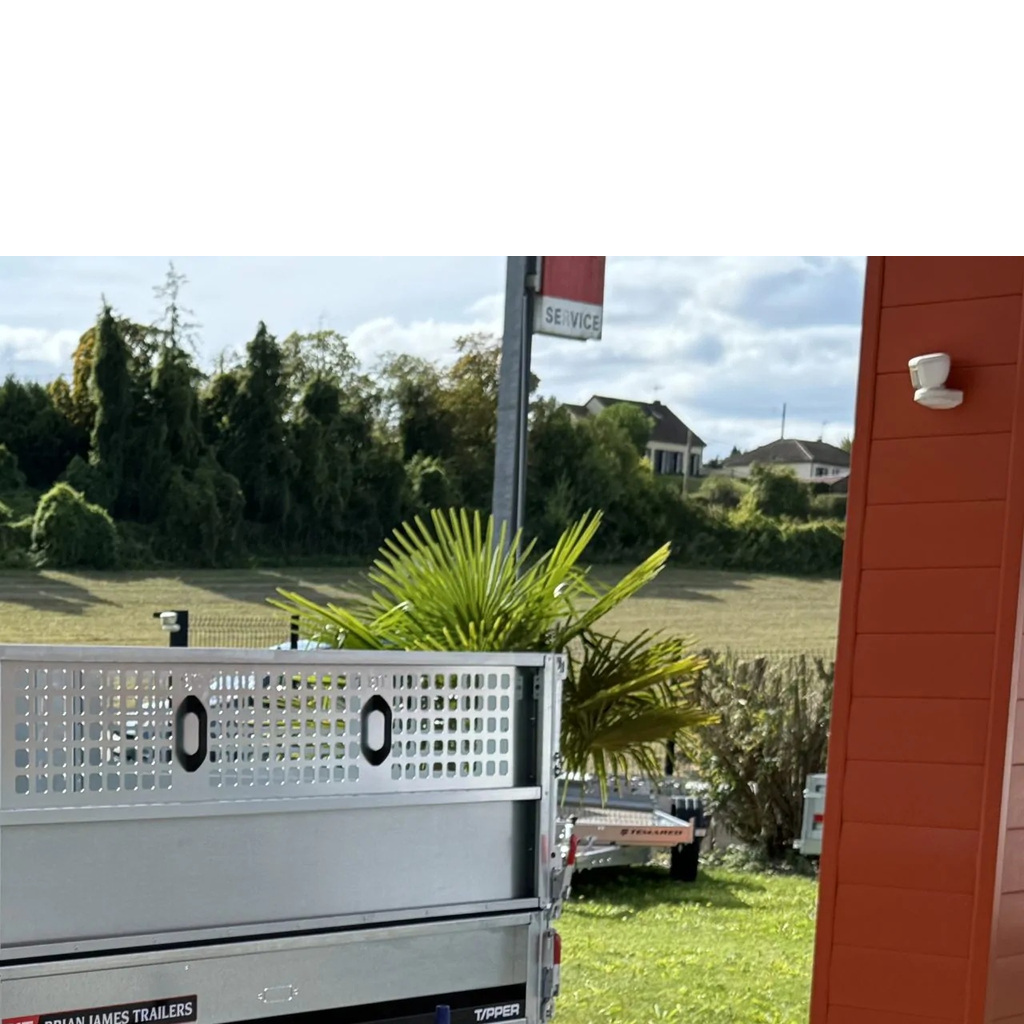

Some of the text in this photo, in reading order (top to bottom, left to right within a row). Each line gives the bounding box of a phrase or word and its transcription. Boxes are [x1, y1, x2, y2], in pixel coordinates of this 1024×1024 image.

[545, 306, 600, 331] SERVICE
[133, 1002, 193, 1023] TRAILERS
[474, 1003, 520, 1021] TIPPER
